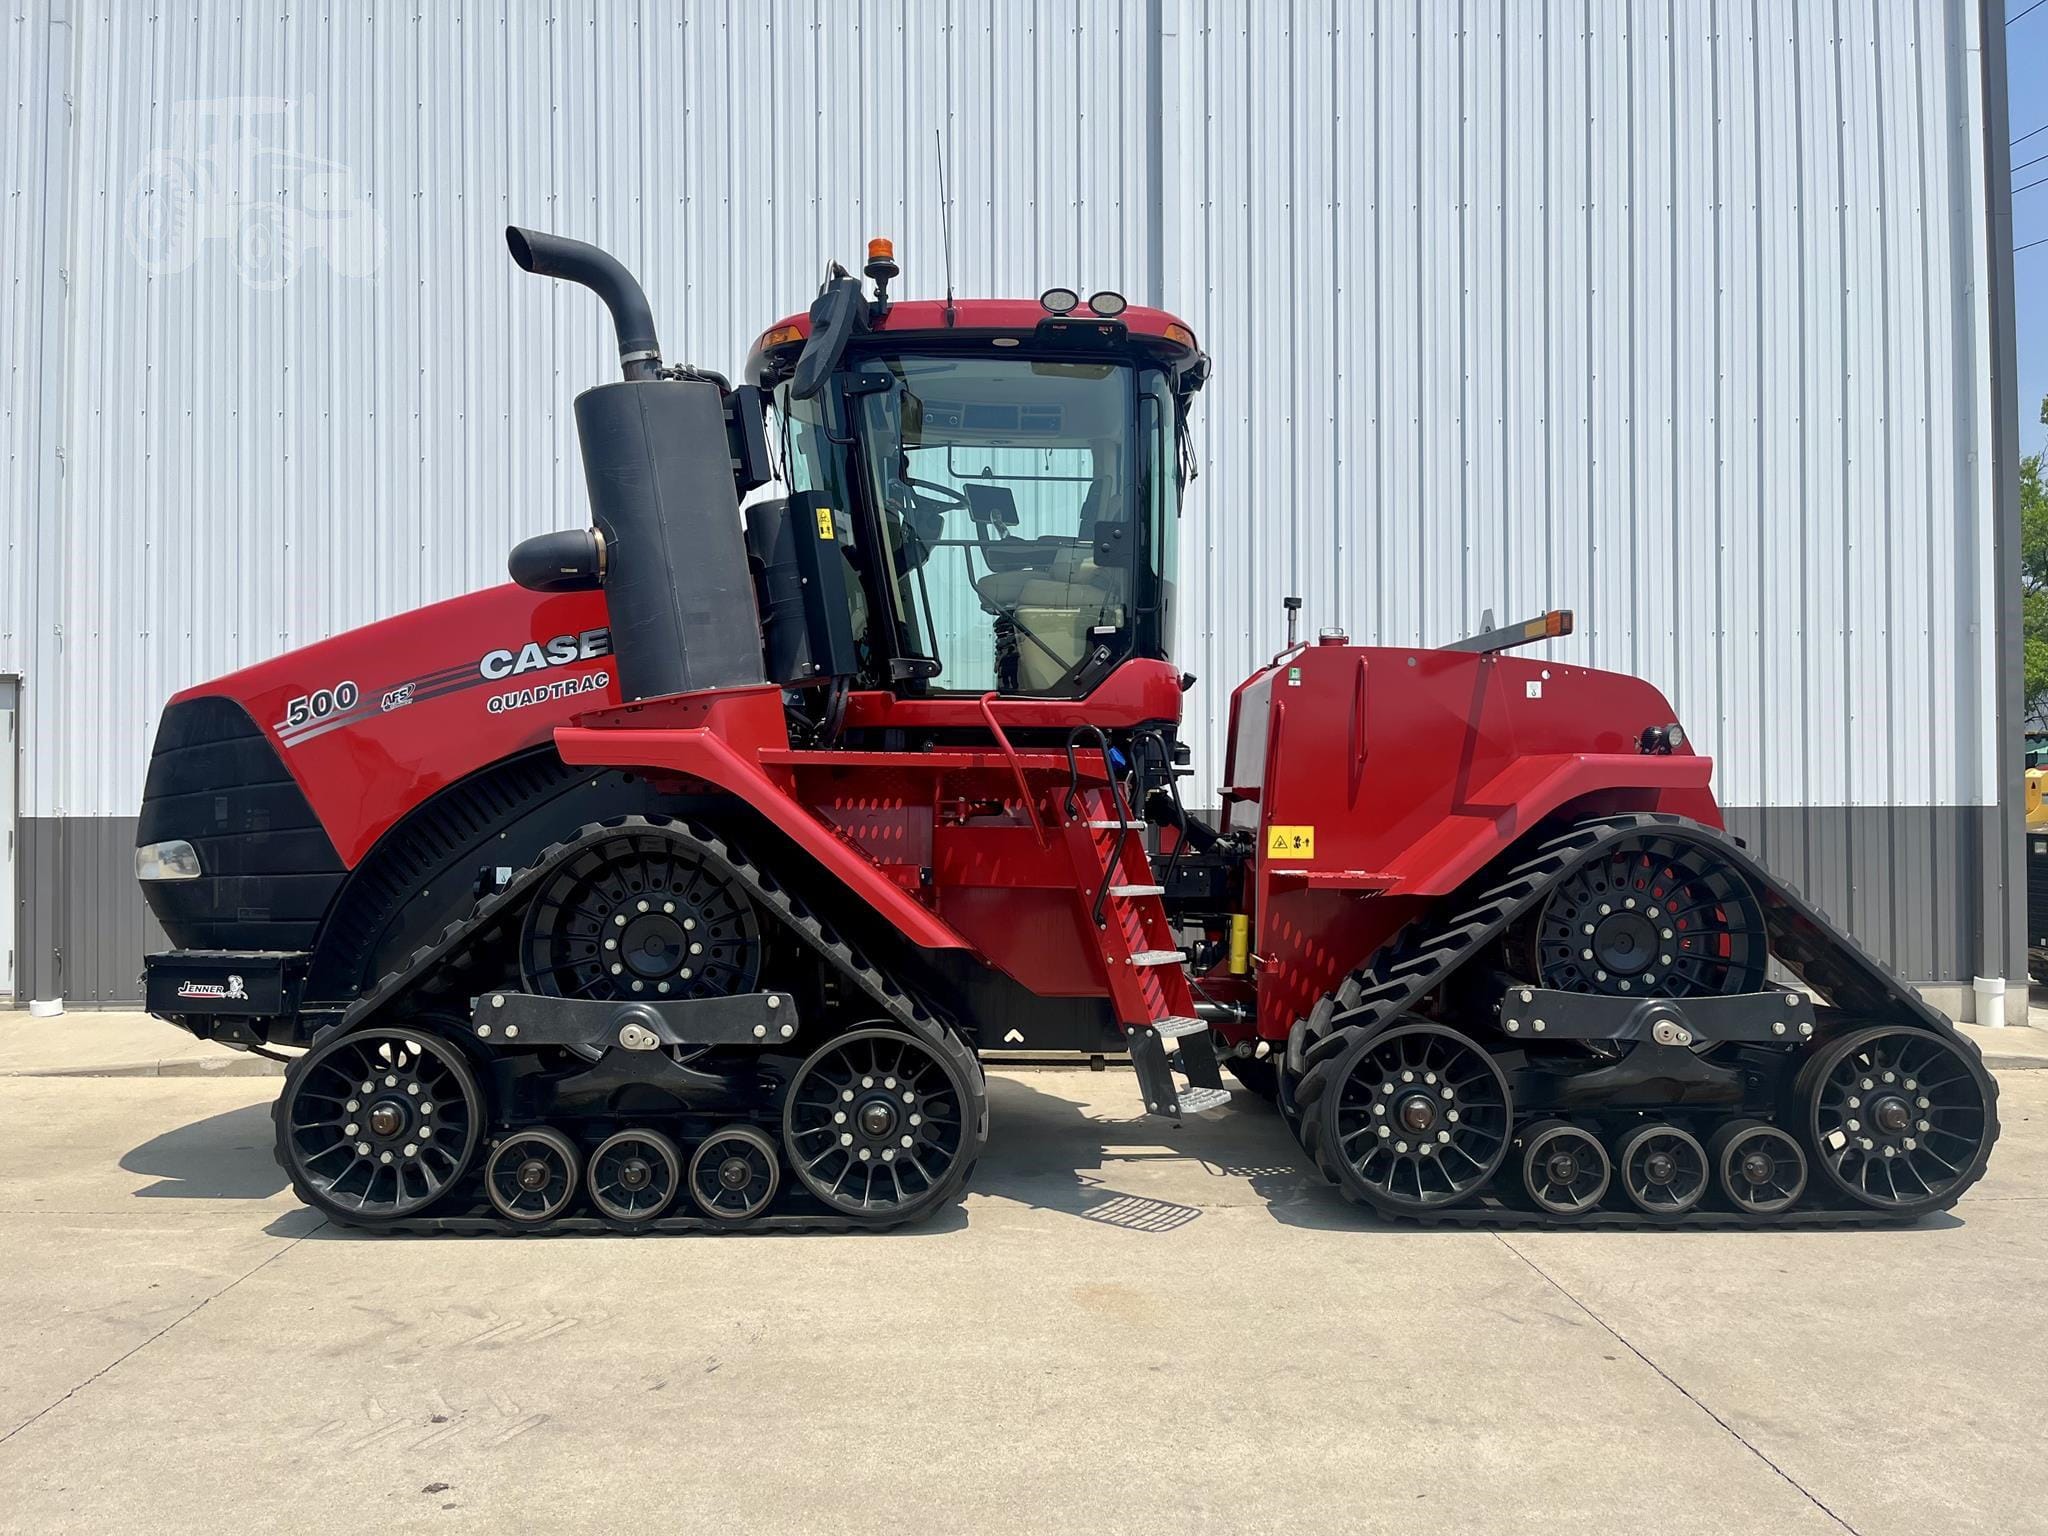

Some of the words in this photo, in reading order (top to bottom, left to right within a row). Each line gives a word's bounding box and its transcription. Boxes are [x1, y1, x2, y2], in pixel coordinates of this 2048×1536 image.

[479, 627, 609, 680] CASE
[286, 680, 359, 727] 500
[382, 688, 409, 707] AFS
[487, 671, 609, 713] QUADTRAC
